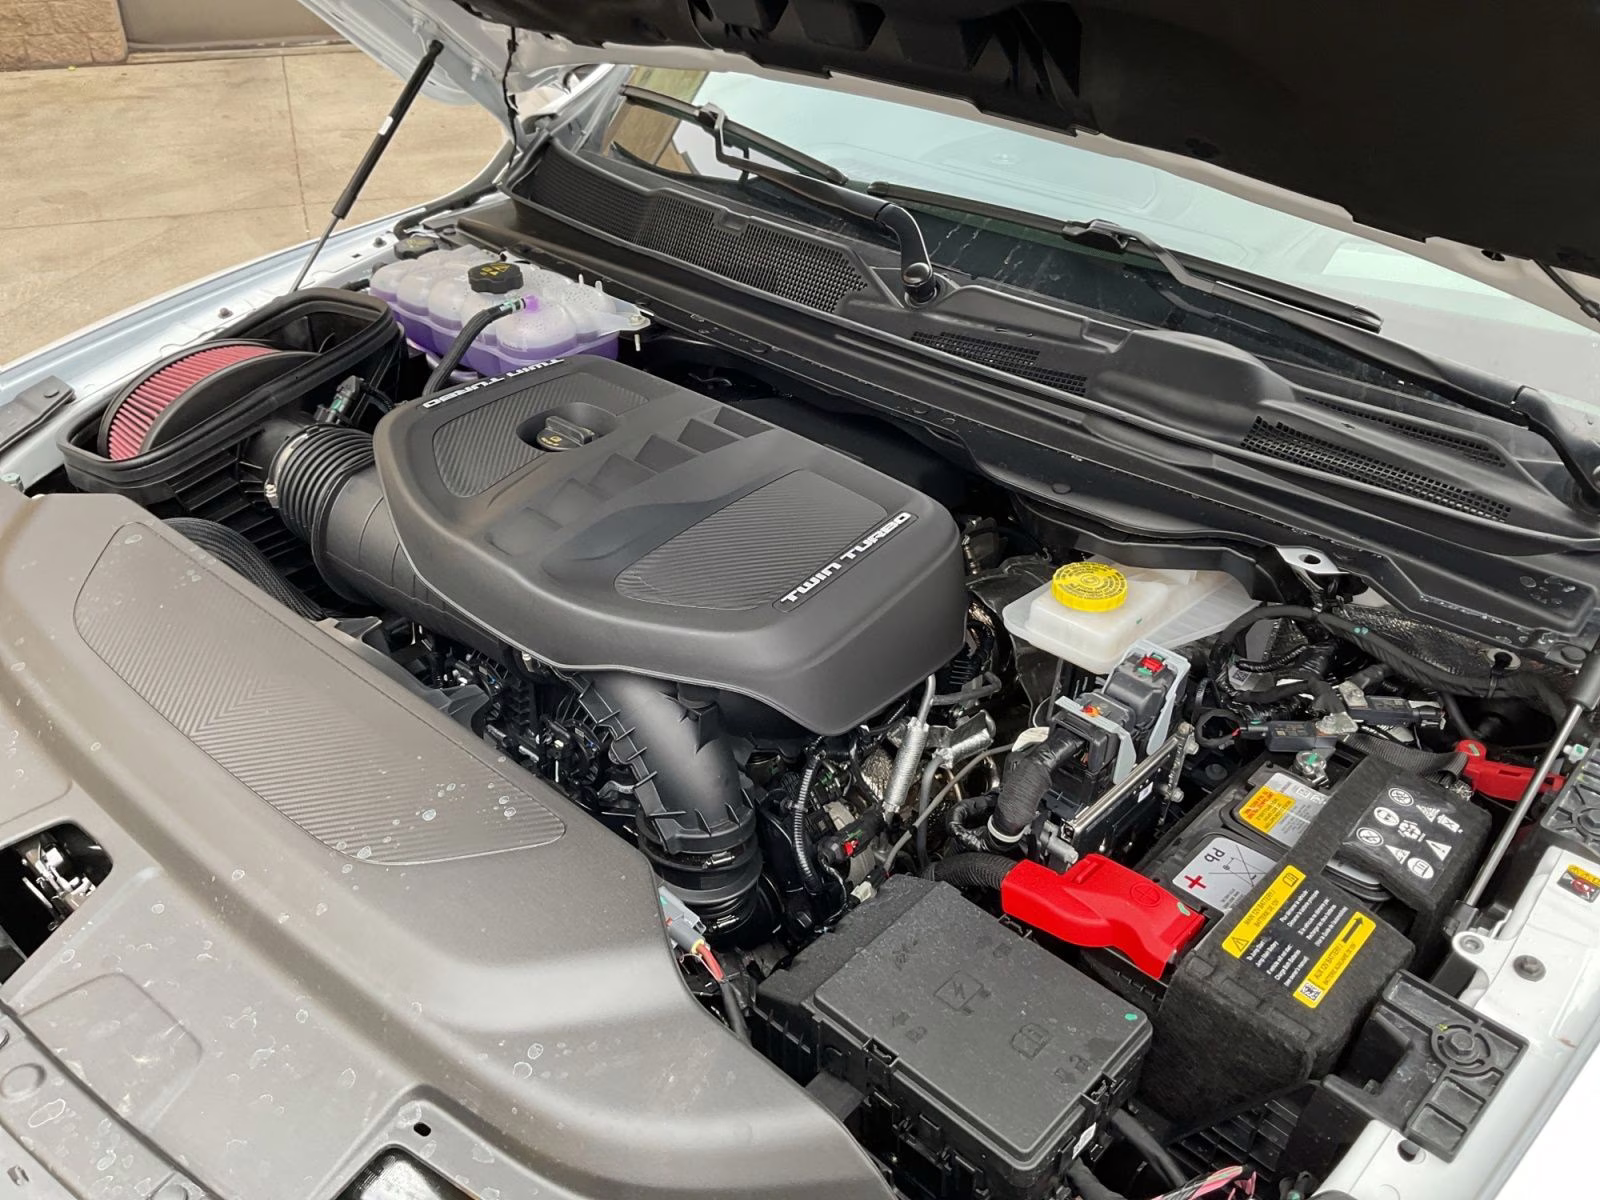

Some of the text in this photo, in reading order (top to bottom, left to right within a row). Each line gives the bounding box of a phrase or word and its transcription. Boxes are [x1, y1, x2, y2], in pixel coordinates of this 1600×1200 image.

[422, 358, 565, 408] TWIN TURBO
[780, 512, 911, 602] TWIN TURBO
